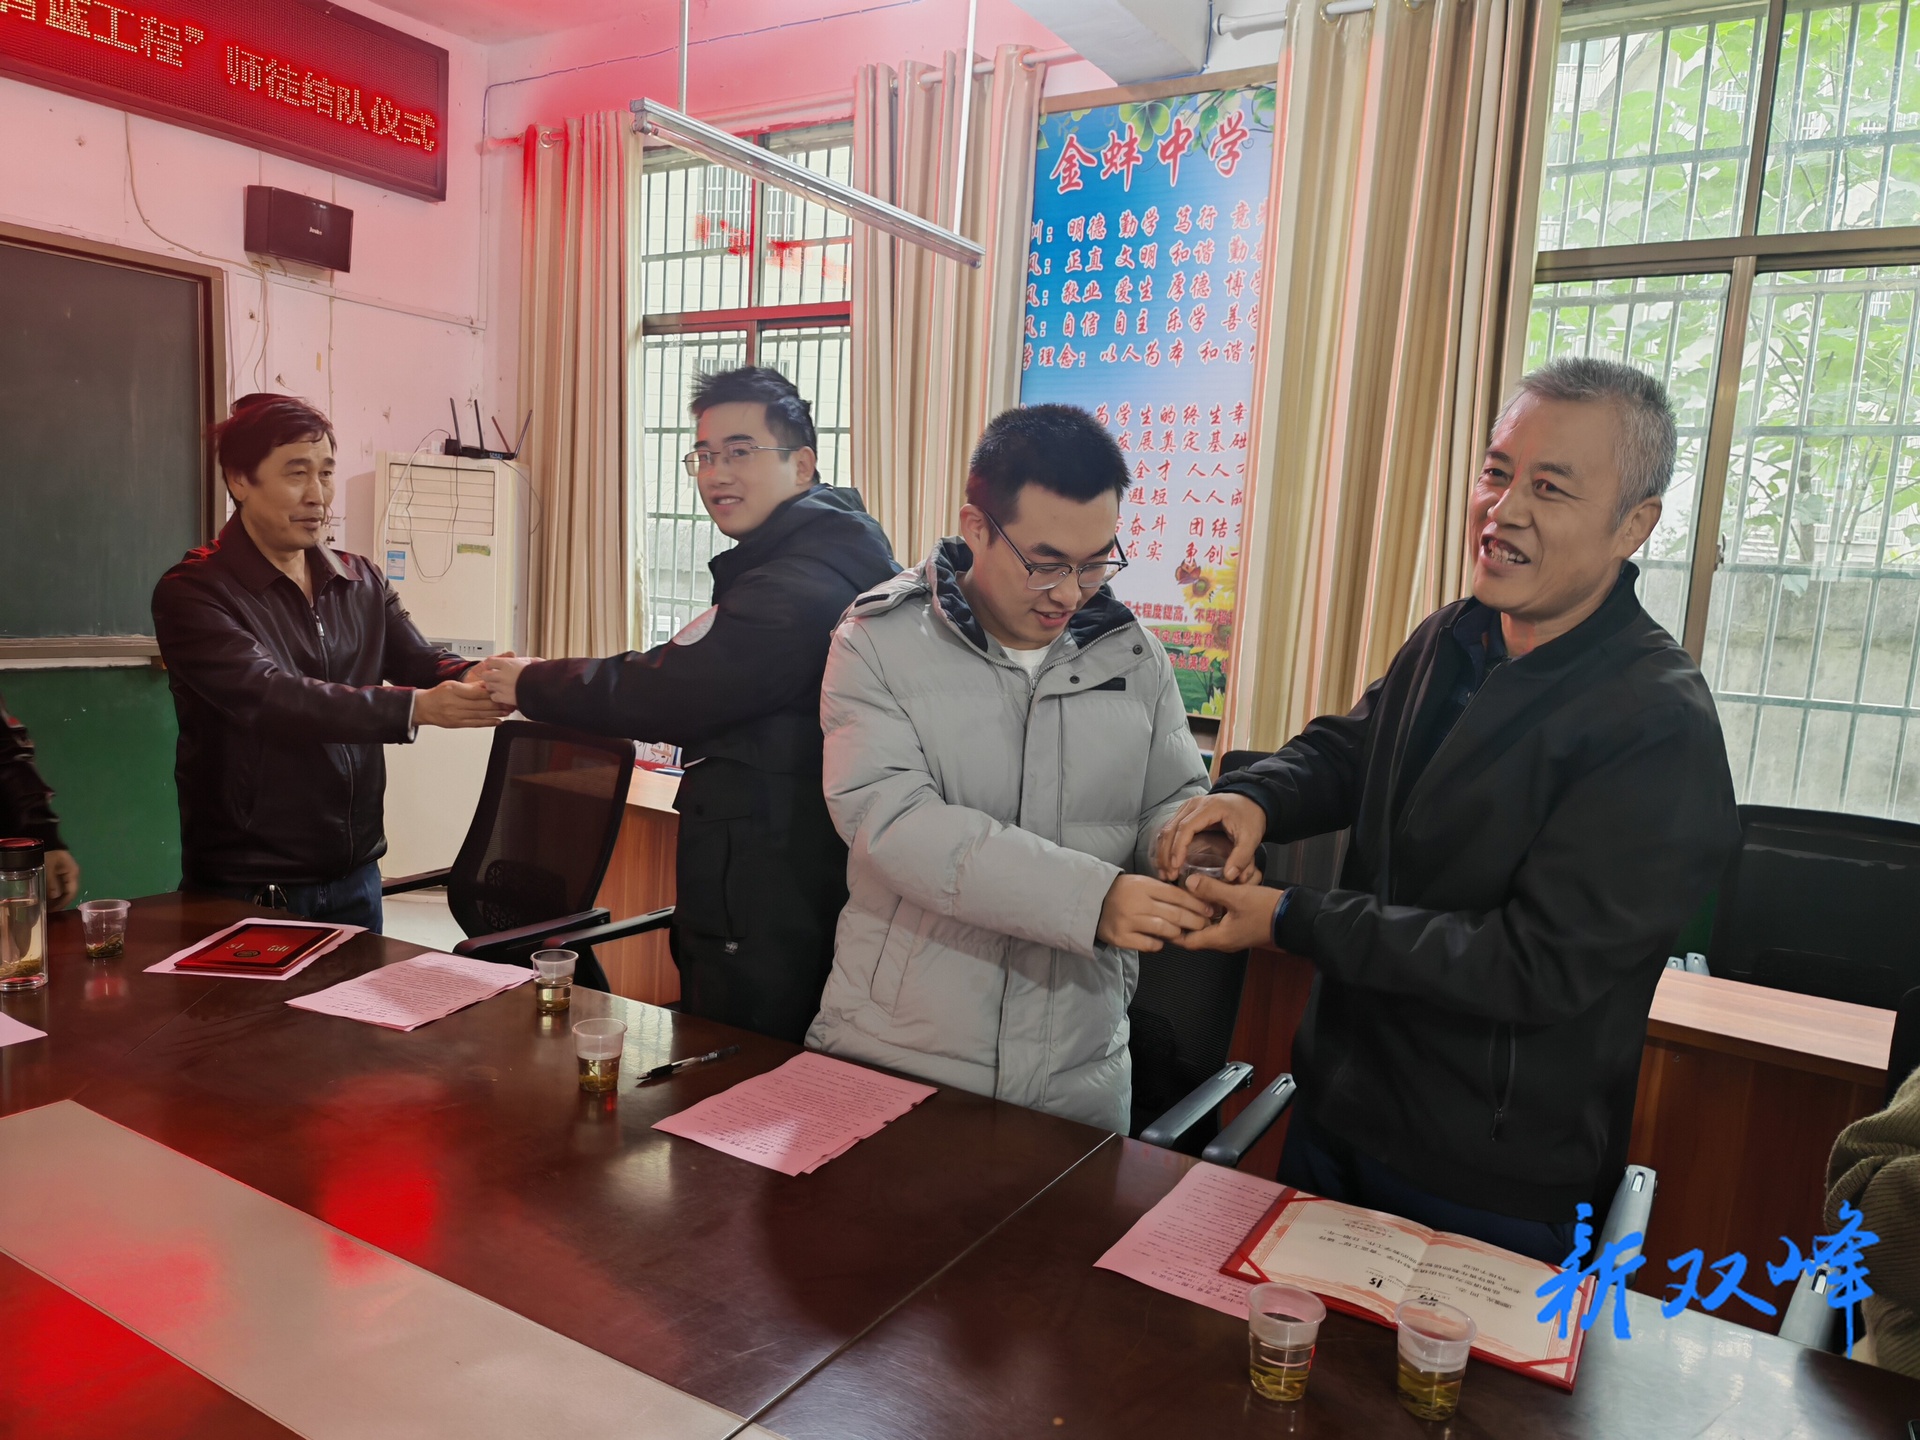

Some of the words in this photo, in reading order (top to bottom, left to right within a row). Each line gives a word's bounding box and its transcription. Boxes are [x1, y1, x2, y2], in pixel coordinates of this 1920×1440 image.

[225, 44, 436, 152] 师徒结队仪式
[1050, 112, 1249, 193] 金蚌中学
[1068, 214, 1107, 242] 明德
[1119, 207, 1159, 237] 勤学
[1175, 205, 1217, 234] 笃行
[1065, 247, 1103, 273] 正直
[1115, 243, 1158, 269] 文明
[1170, 240, 1215, 265] 和谐
[1061, 280, 1102, 304] 敬业
[1115, 275, 1153, 303] 爱生
[1167, 271, 1211, 302] 厚德
[1062, 310, 1099, 338] 自信
[1114, 309, 1148, 335] 自主
[1166, 303, 1207, 333] 乐学
[1100, 339, 1185, 368] 以人为本
[1200, 337, 1256, 366] 和谐
[1094, 401, 1248, 428] 为学生的终生幸
[1117, 429, 1248, 455] 发展奠定基础
[1133, 459, 1171, 482] 全才
[1128, 486, 1168, 506] 避短
[1109, 540, 1163, 562] 求实
